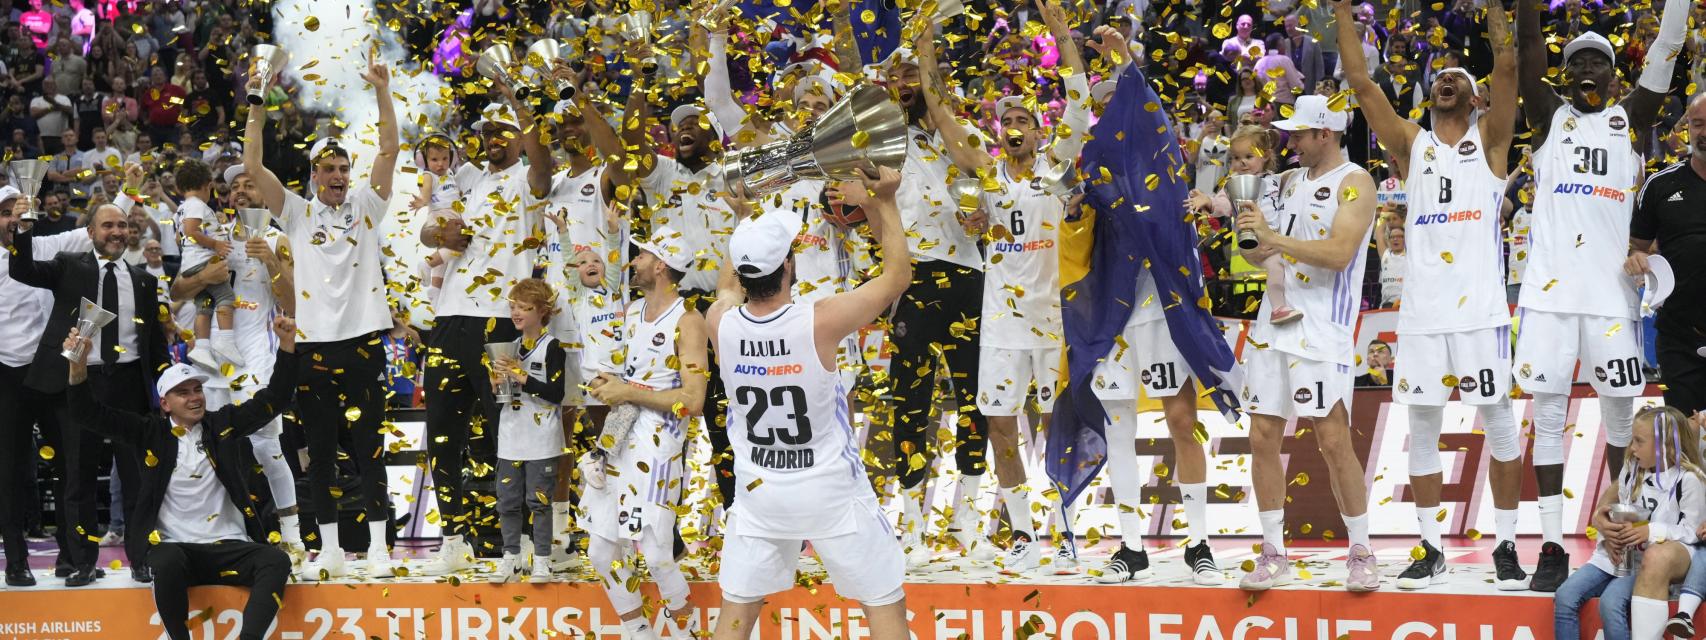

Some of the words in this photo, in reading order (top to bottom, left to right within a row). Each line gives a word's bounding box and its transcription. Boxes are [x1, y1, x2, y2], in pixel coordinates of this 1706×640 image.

[1573, 146, 1608, 176] 30
[1553, 183, 1626, 203] AUTOHERO
[1010, 210, 1025, 236] 6
[1286, 213, 1297, 236] 1
[1414, 210, 1482, 225] AUTOHERO
[612, 325, 623, 341] 5
[740, 338, 791, 357] LLULL
[734, 364, 803, 376] AUTOHERO
[1150, 361, 1179, 390] 31
[1479, 368, 1495, 397] 8
[1607, 356, 1642, 388] 30
[1315, 381, 1326, 409] 1
[735, 385, 813, 445] 23
[750, 446, 815, 469] MADRID
[629, 507, 642, 533] 5
[41, 620, 102, 633] AIRLINES
[150, 607, 367, 640] 02-23
